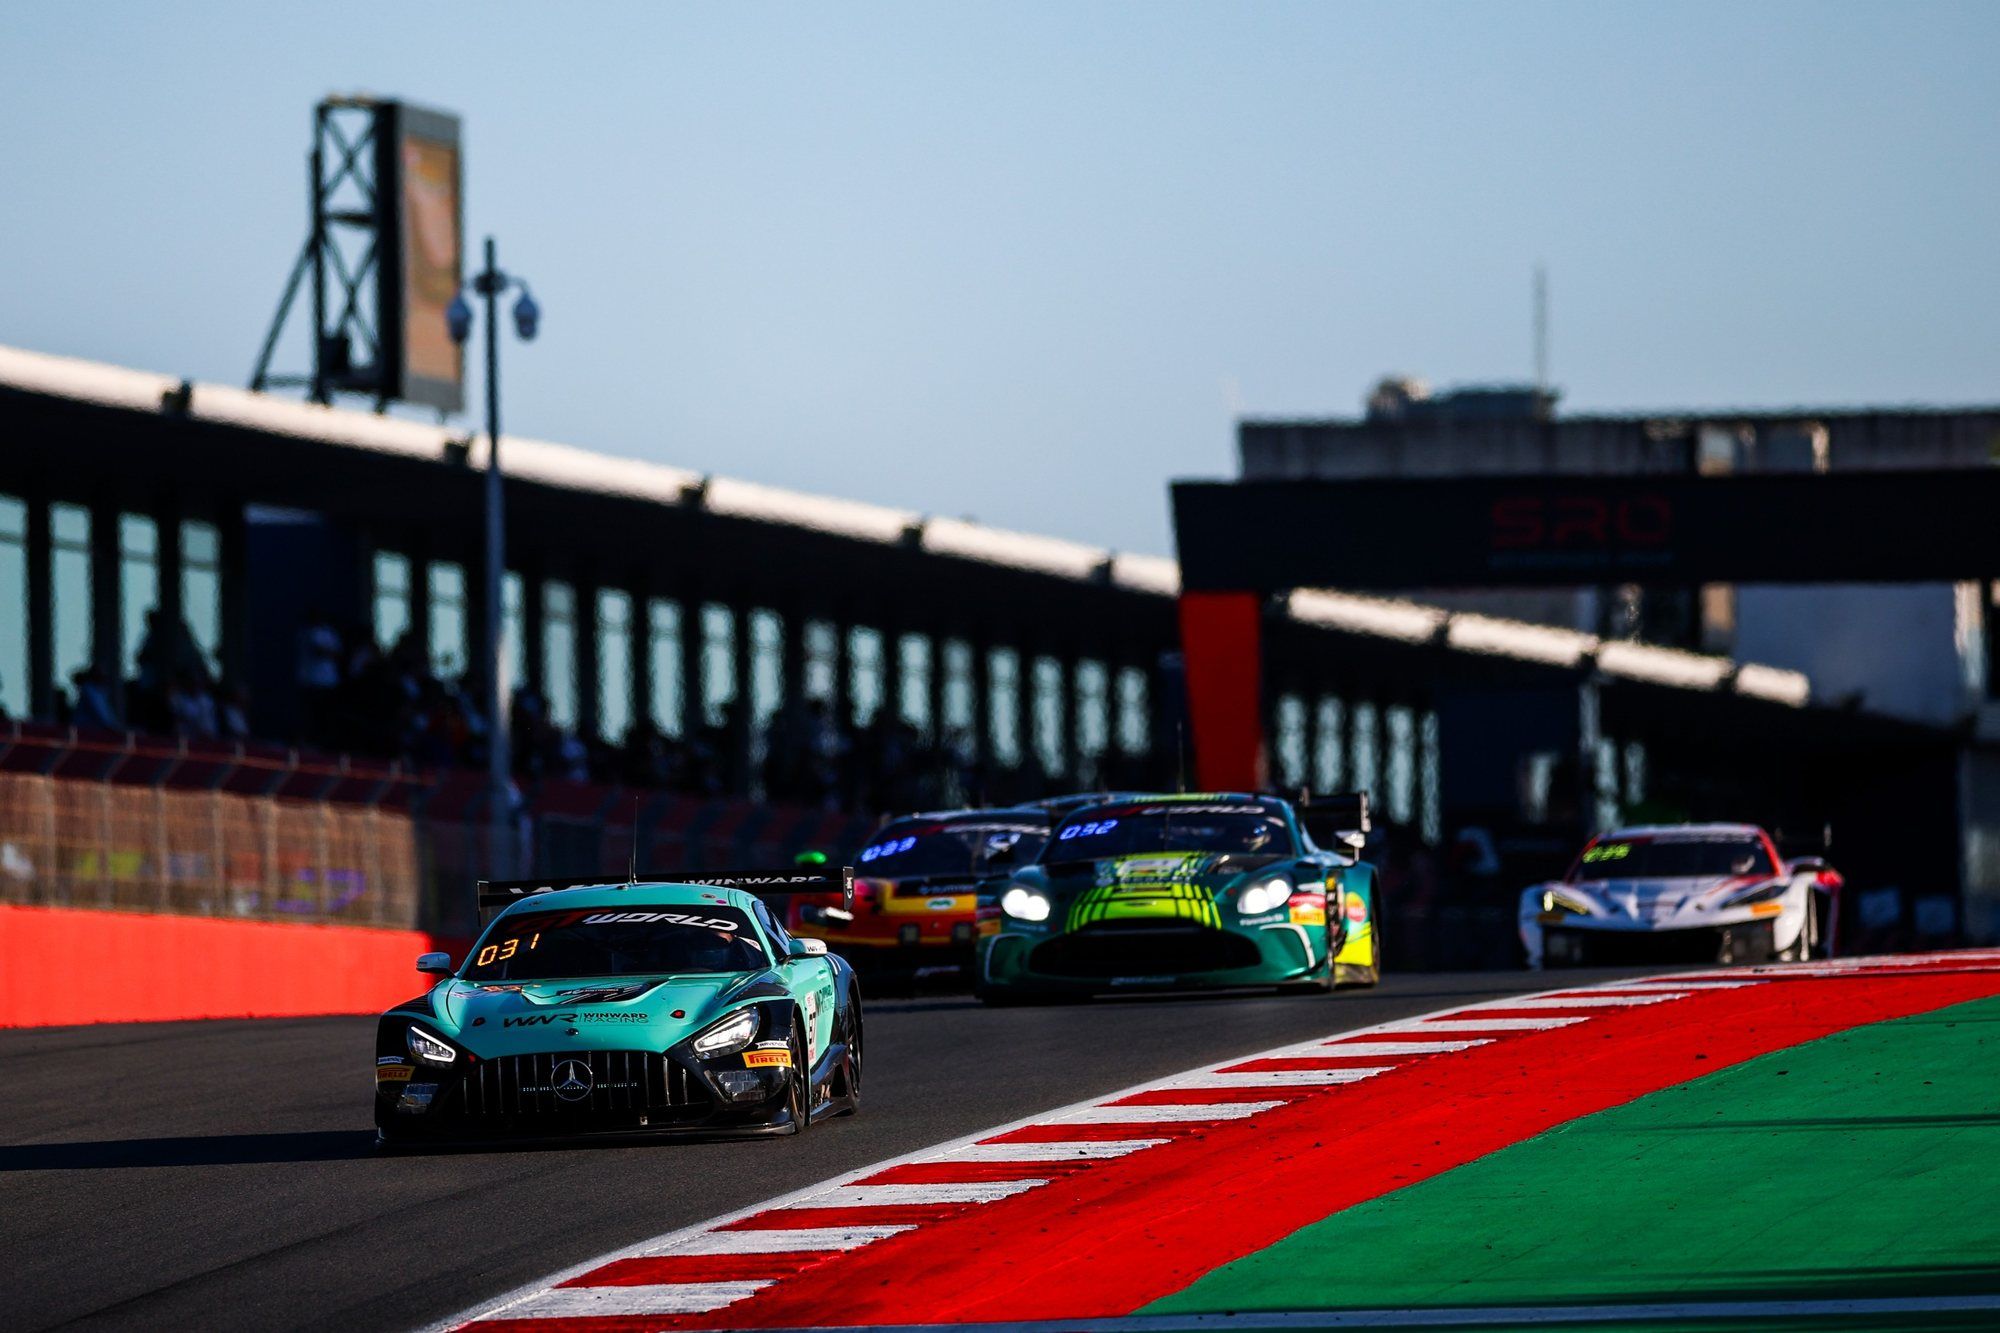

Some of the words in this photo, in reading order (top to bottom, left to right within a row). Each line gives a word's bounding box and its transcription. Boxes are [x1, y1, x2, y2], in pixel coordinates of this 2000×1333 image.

[1489, 494, 1676, 549] SRO
[688, 875, 827, 886] WINWARD
[581, 911, 739, 932] WORLD
[477, 933, 539, 967] 031
[748, 1052, 788, 1064] PIRELLI
